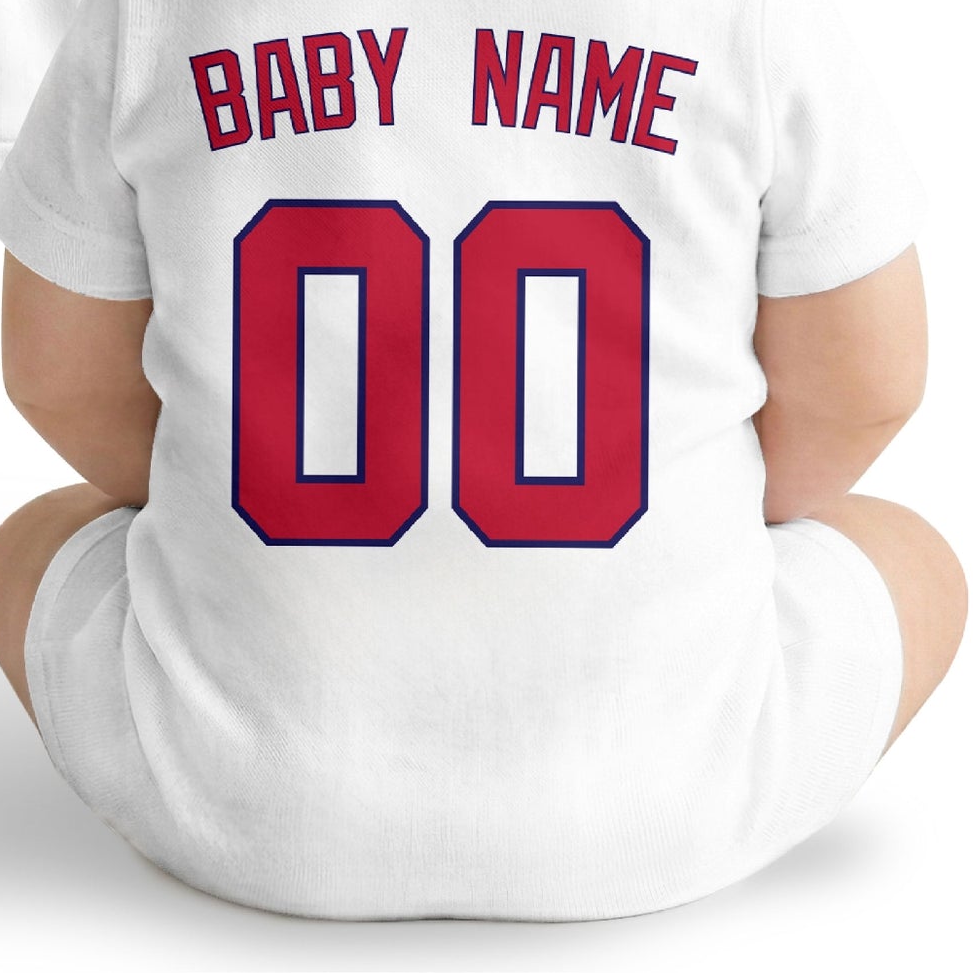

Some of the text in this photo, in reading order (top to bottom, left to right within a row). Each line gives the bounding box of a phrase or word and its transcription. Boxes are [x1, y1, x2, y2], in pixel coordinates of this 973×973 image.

[189, 27, 699, 156] BABY NAME
[231, 198, 651, 549] 00
